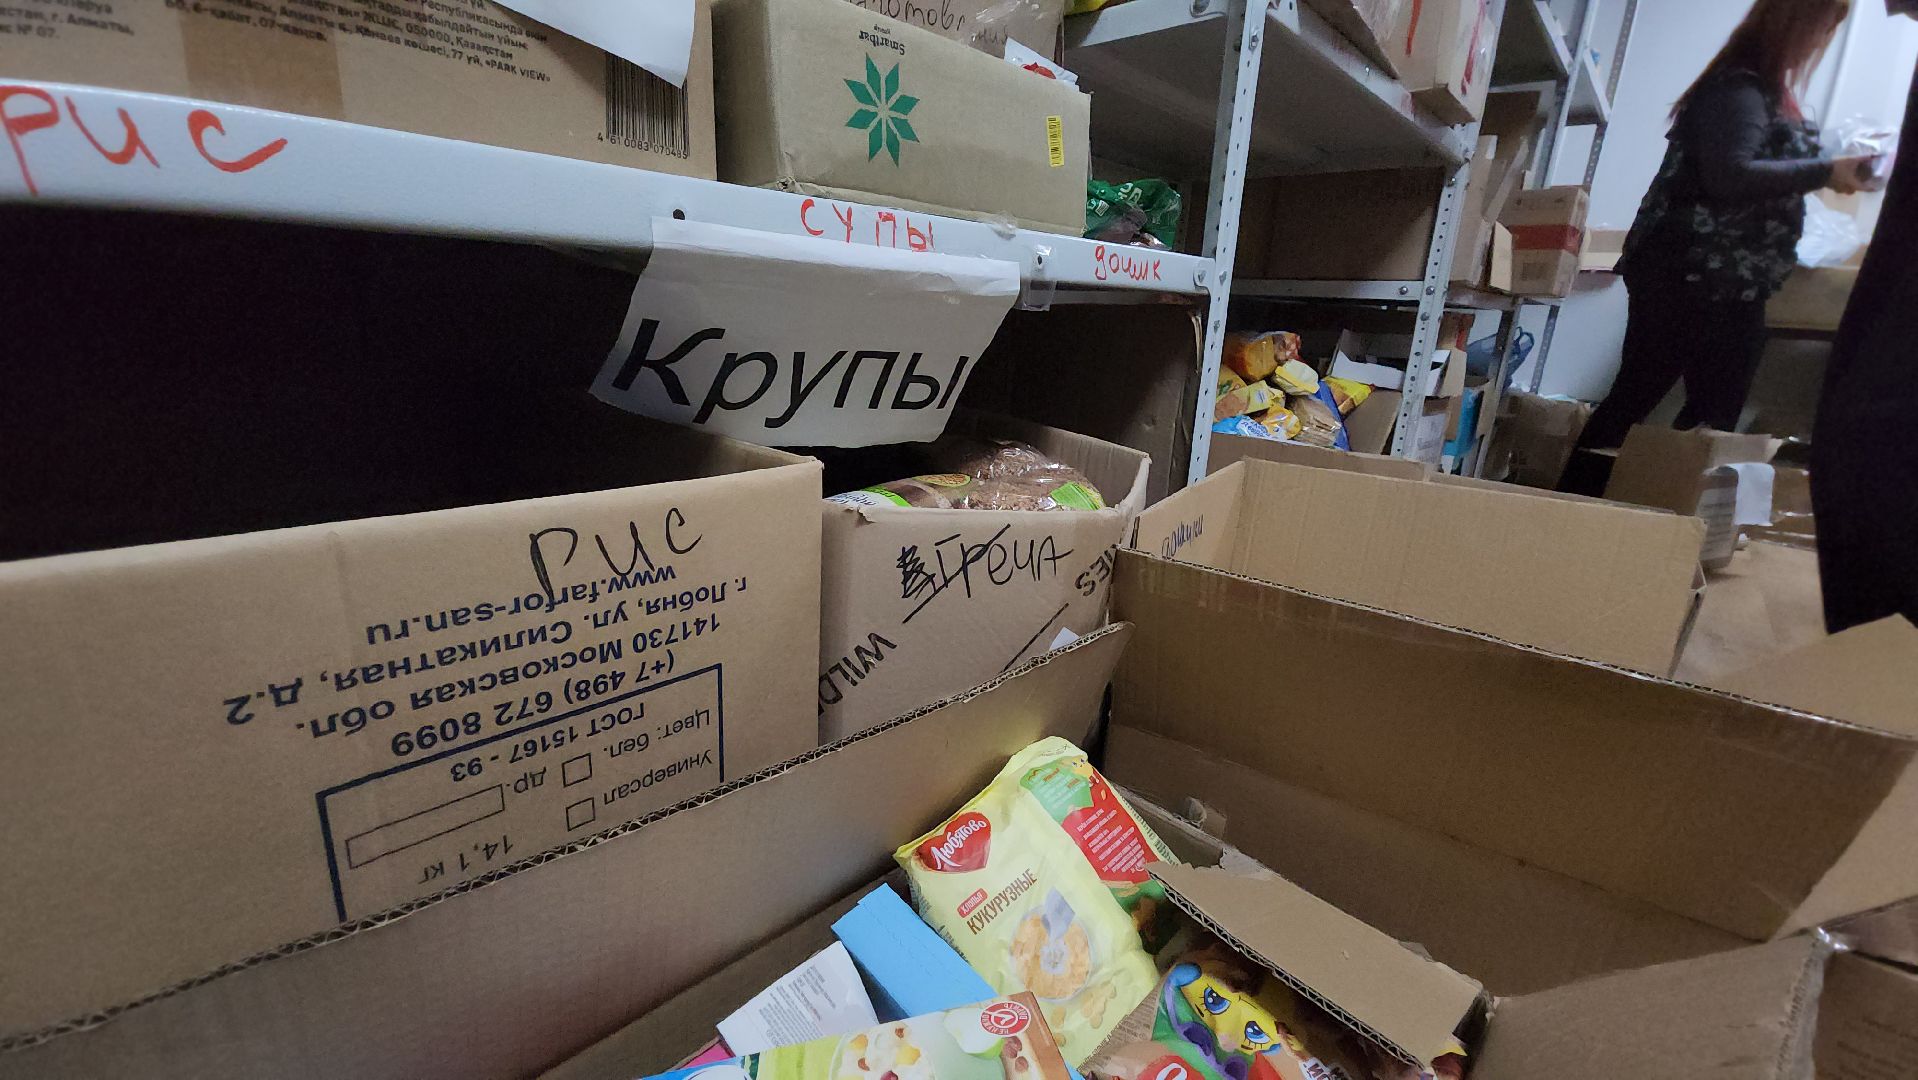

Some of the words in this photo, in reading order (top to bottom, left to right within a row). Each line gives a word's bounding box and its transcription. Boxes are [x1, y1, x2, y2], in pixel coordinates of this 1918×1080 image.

[451, 48, 464, 61] 77
[610, 318, 970, 429] Крупы
[733, 576, 748, 592] г.
[1074, 542, 1122, 598] IES
[583, 601, 630, 630] ул.
[637, 581, 728, 616] Лобня,
[632, 612, 721, 654] 141730
[320, 620, 574, 693] Силикатная,
[409, 638, 623, 712] Московская
[635, 648, 676, 683] (+7
[818, 632, 898, 717] WILD
[563, 669, 627, 706] 498)
[295, 699, 396, 739] обл.
[493, 689, 555, 727] 672
[585, 701, 646, 739] ГОСТ
[656, 707, 712, 741] Цвет:
[390, 711, 483, 758] 8099
[508, 724, 580, 766] 15167
[602, 731, 651, 759] бел.
[449, 755, 485, 784] 93
[505, 765, 548, 796] др.
[602, 748, 714, 806] Универсал
[930, 818, 988, 870] Любятово
[416, 861, 446, 885] кг
[965, 867, 1039, 937] КУКУРУЗНЫЕ
